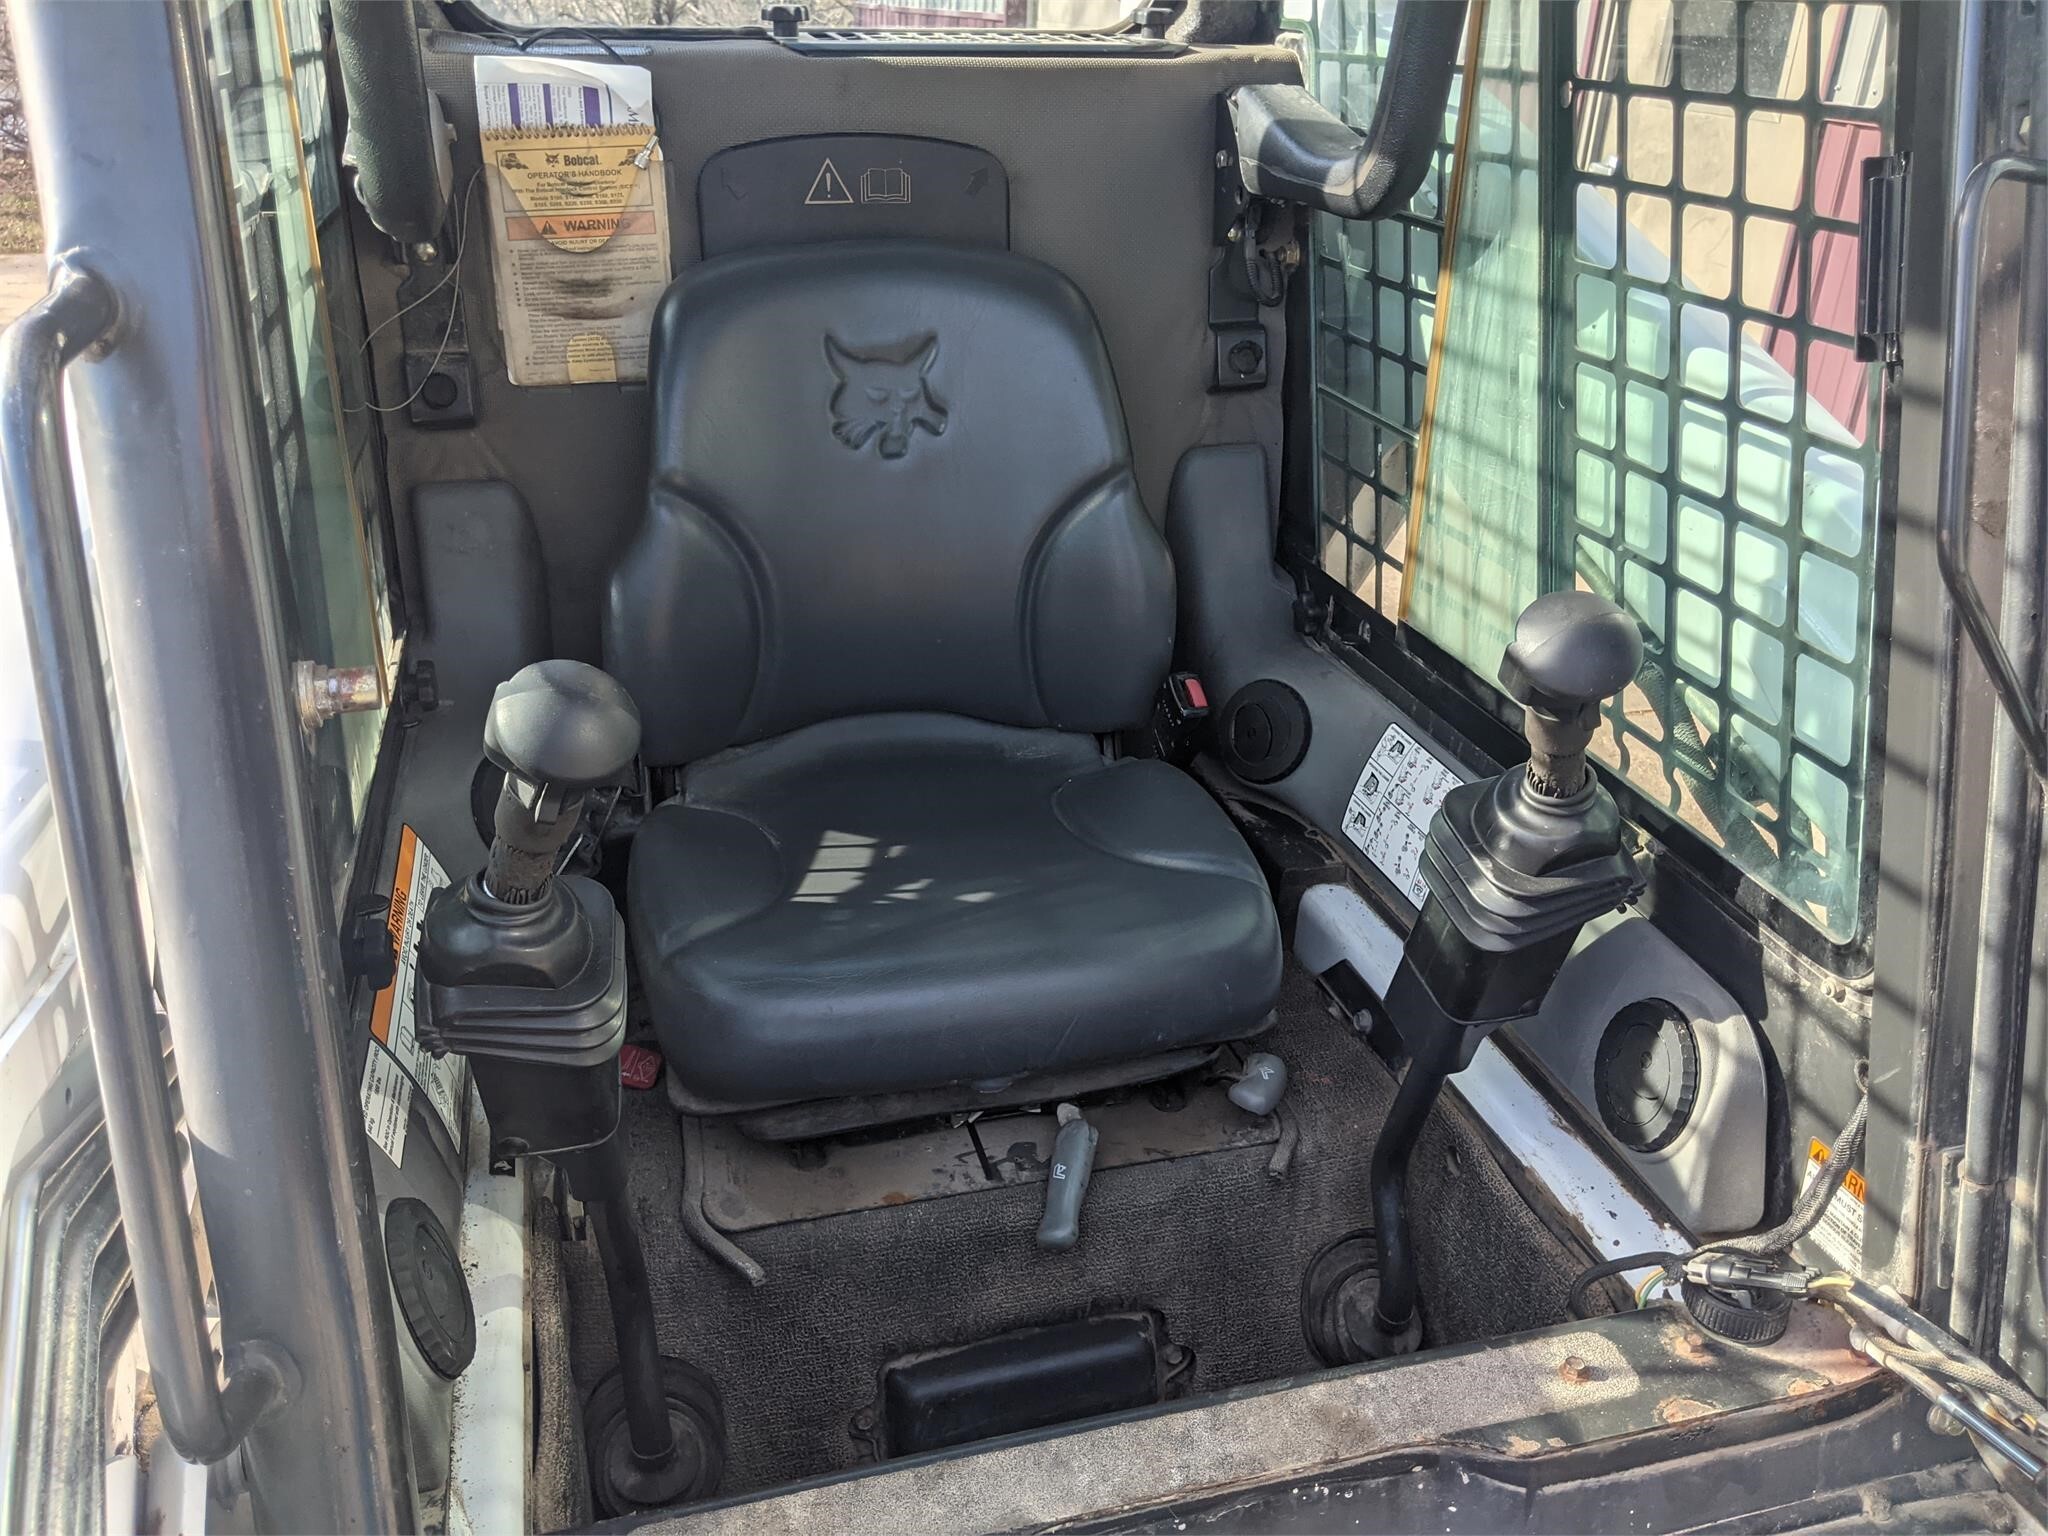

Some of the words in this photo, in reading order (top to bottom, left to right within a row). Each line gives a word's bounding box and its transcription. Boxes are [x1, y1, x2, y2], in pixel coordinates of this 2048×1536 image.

[527, 170, 577, 179] OPERATOR'S
[578, 169, 623, 177] HANDBOOK
[563, 218, 631, 231] WARNING
[400, 946, 408, 966] AVOID
